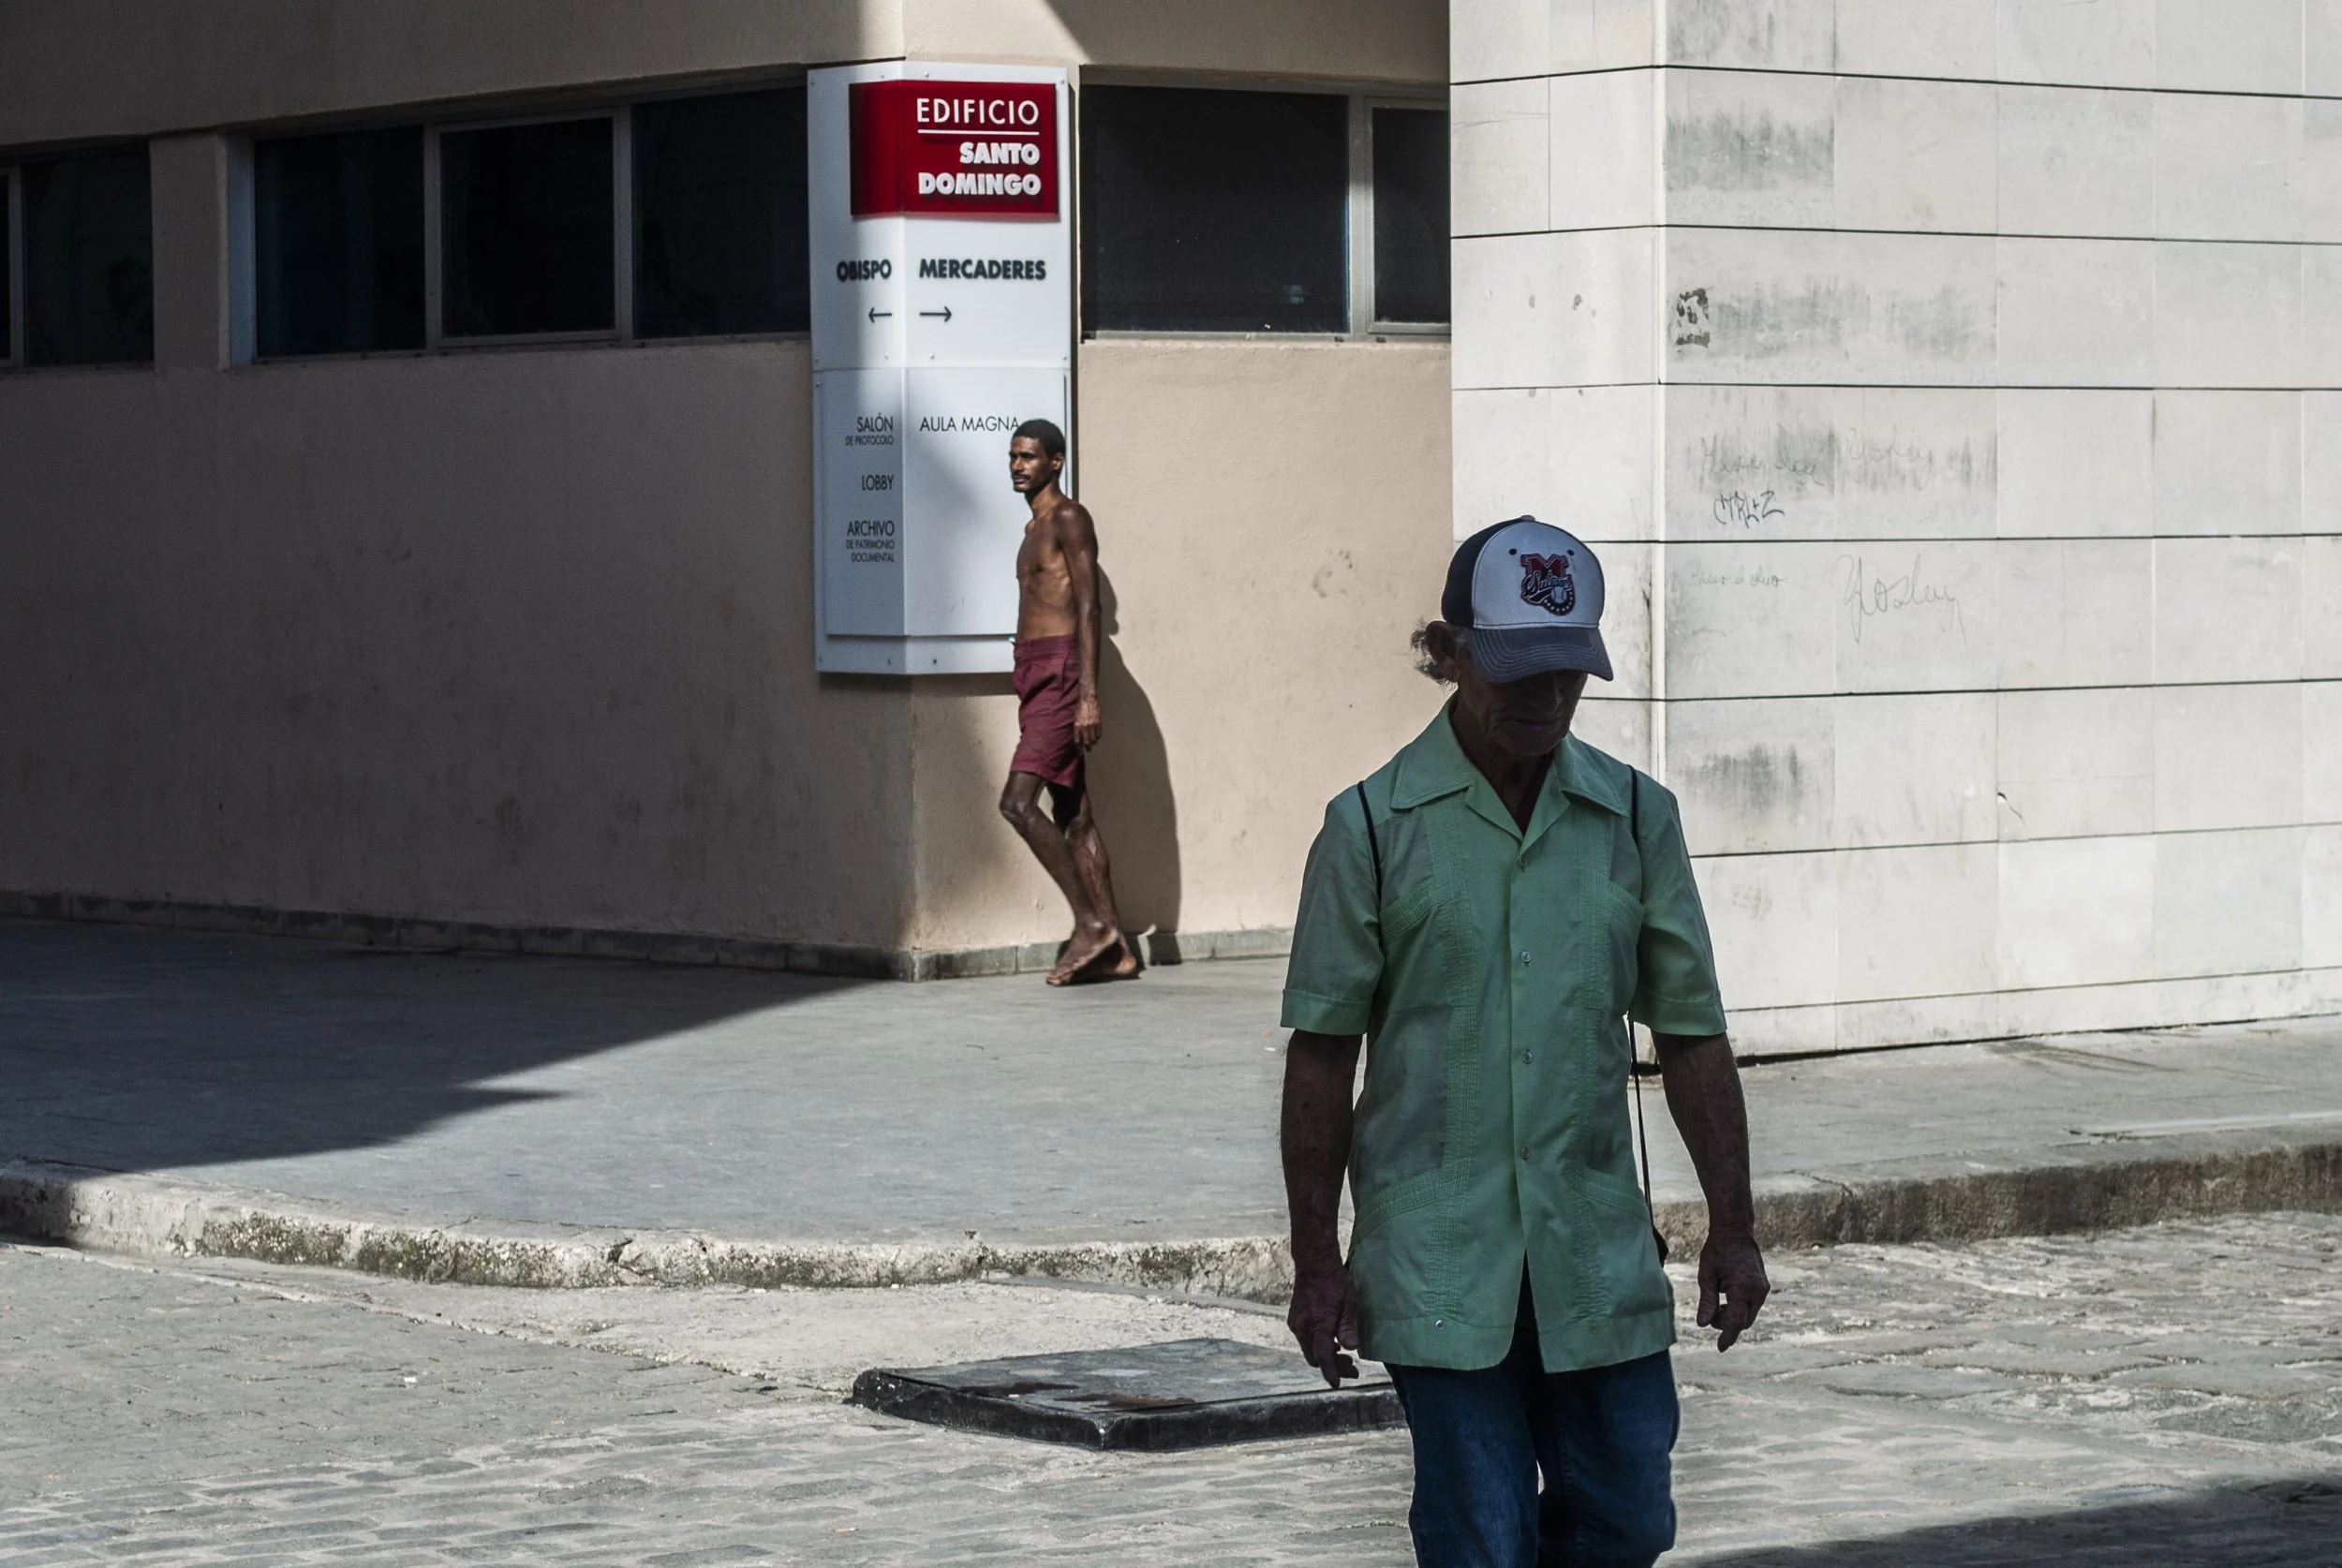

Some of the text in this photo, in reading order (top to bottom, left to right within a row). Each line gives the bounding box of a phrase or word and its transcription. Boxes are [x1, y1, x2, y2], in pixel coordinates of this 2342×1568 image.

[916, 98, 1039, 125] EDIFICIO
[959, 141, 1040, 165] SANTO
[918, 172, 1042, 196] DOMINGO
[837, 259, 892, 281] OBISPO
[919, 259, 1046, 280] MERCADERES
[856, 412, 894, 433] SALÓN
[919, 416, 1019, 432] AULA MAGNA
[845, 435, 894, 446] DE PROTOCOLO
[862, 475, 894, 491] LOBBY
[847, 520, 895, 537] ARCHIVO
[846, 539, 895, 550] DE PATRIMONIO
[851, 552, 895, 563] DOCUMENTAL
